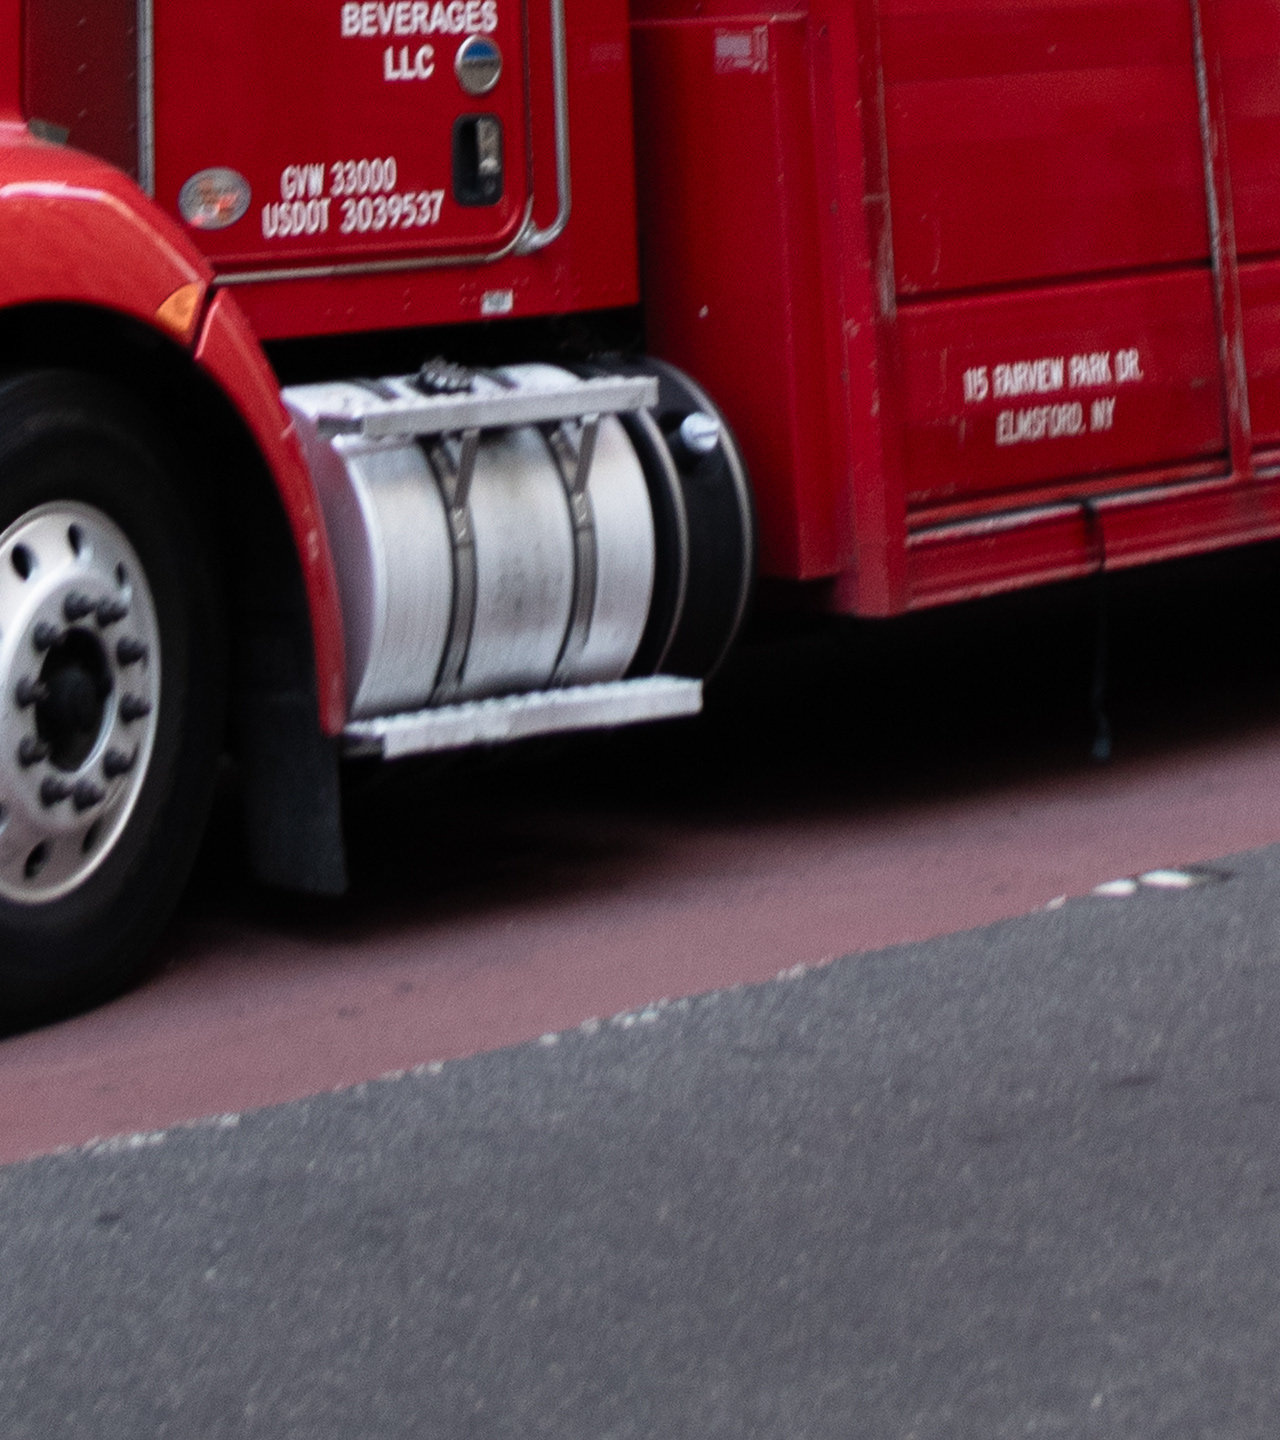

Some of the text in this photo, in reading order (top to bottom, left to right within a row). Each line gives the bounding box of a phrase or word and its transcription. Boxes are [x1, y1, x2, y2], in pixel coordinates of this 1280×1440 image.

[383, 43, 435, 81] LLC
[280, 156, 397, 200] GVW 33000
[261, 188, 446, 239] USDOT 3039537
[963, 366, 989, 404] 115
[992, 355, 1065, 399] FAIRVIEW
[1068, 350, 1113, 389] PARK
[1089, 395, 1117, 432] NY
